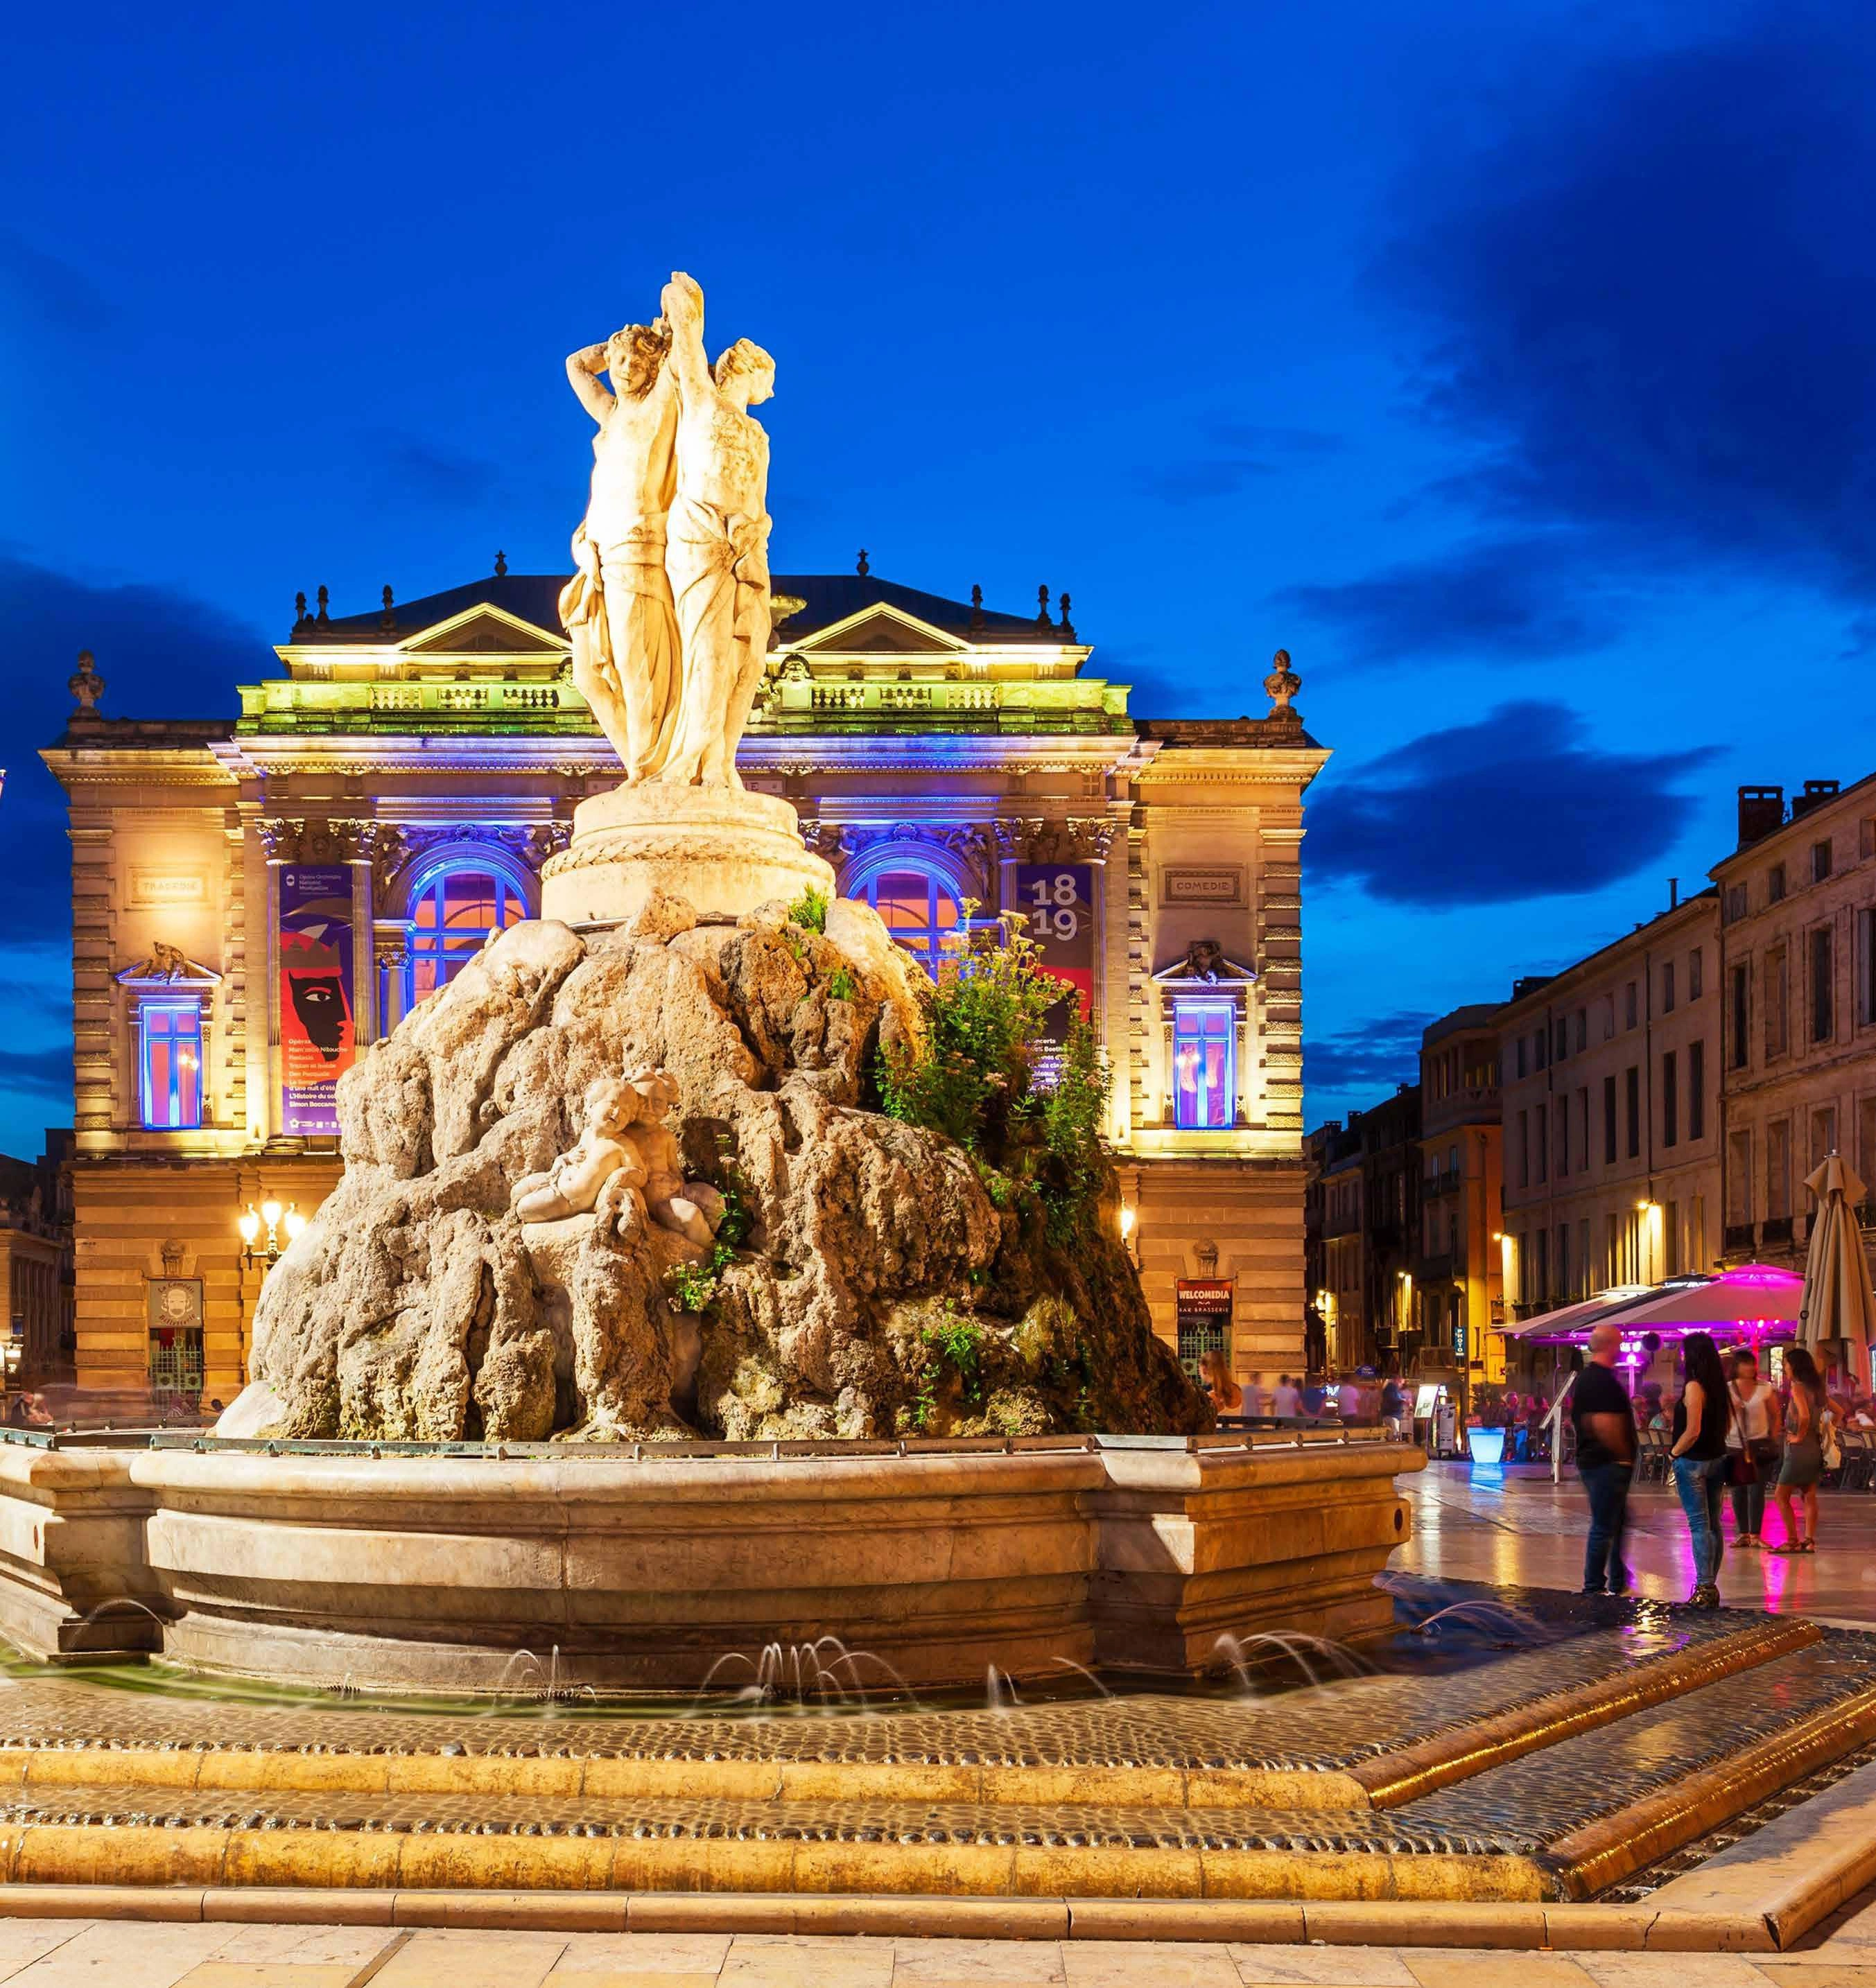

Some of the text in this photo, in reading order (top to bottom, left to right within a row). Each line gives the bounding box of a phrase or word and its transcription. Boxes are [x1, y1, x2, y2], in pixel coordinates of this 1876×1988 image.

[1032, 873, 1077, 906] 18
[1032, 908, 1077, 941] 19
[1179, 1290, 1231, 1300] WELCOMEDIA
